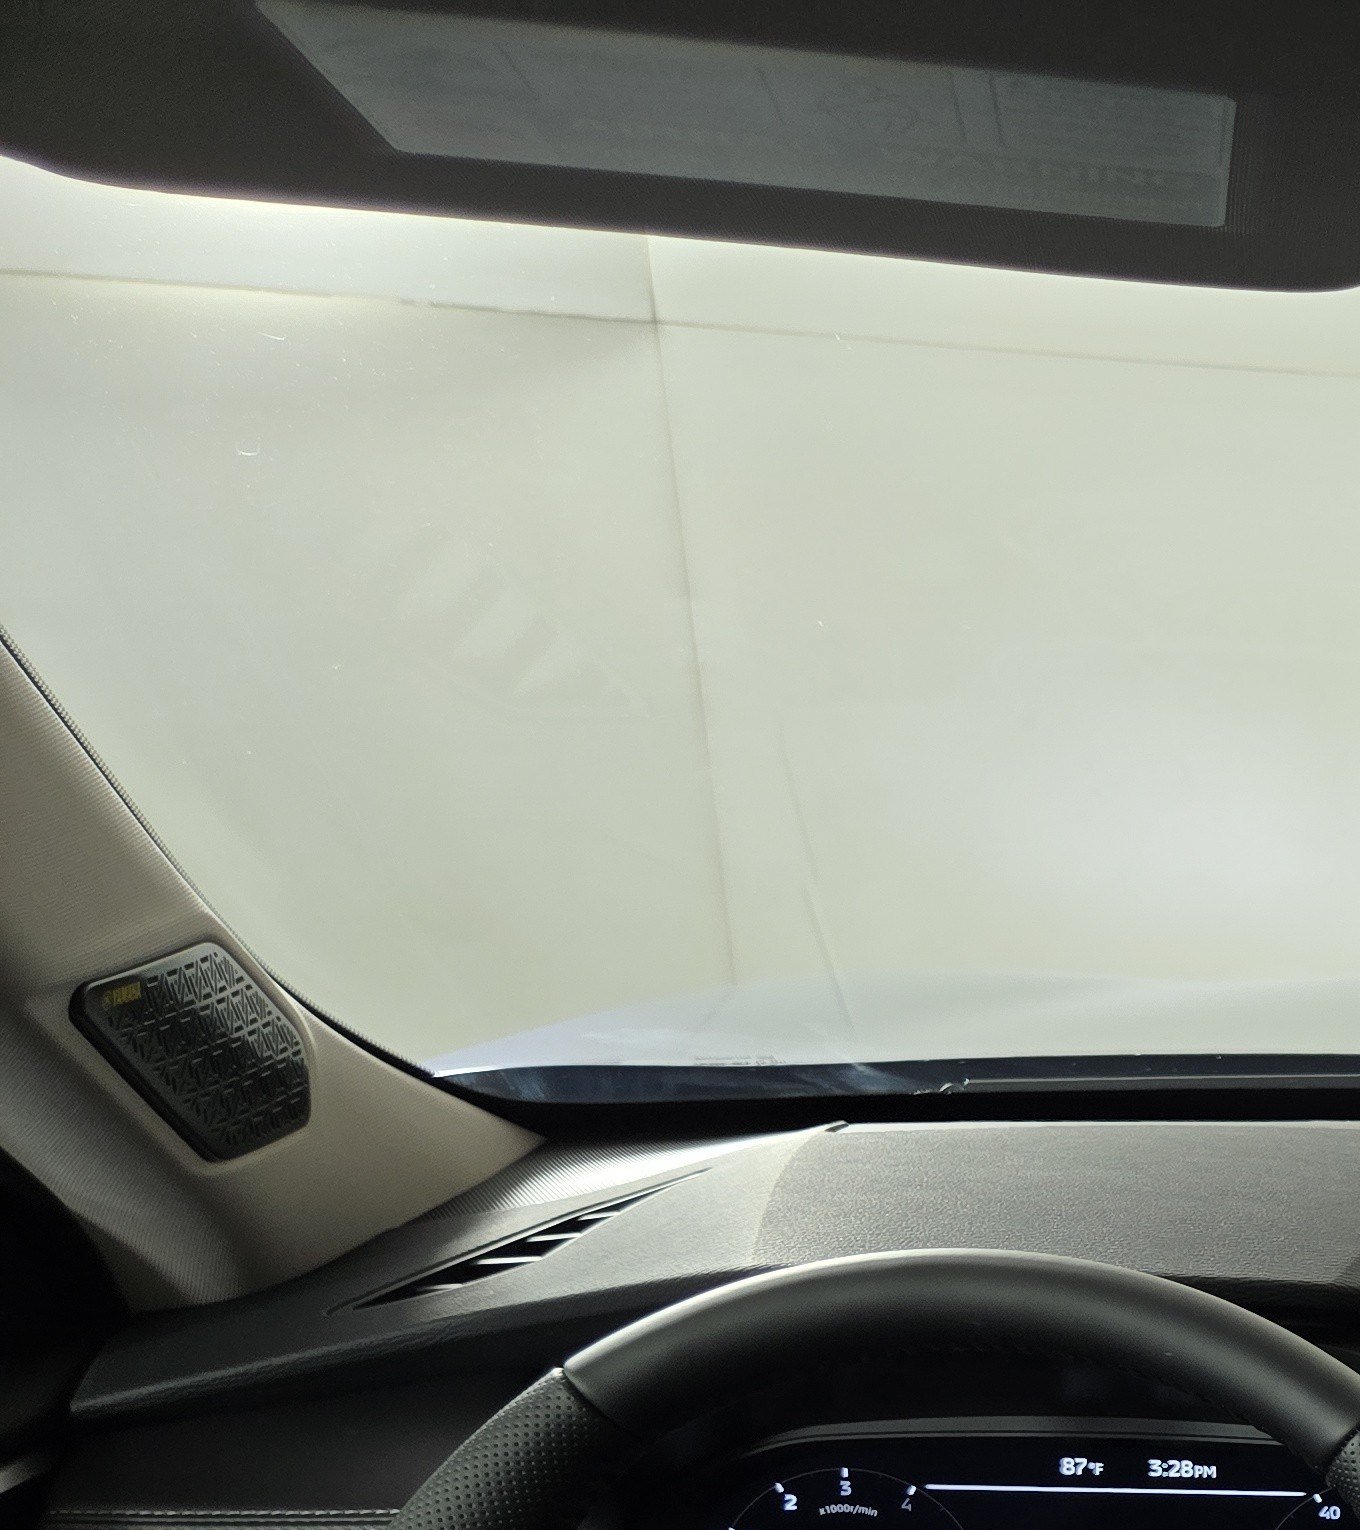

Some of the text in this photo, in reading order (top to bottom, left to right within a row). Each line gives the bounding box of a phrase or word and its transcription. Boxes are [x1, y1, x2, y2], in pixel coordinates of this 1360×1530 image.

[840, 1481, 852, 1496] 3
[784, 1495, 798, 1511] 2
[901, 1498, 912, 1511] 4
[1318, 1506, 1341, 1521] 40
